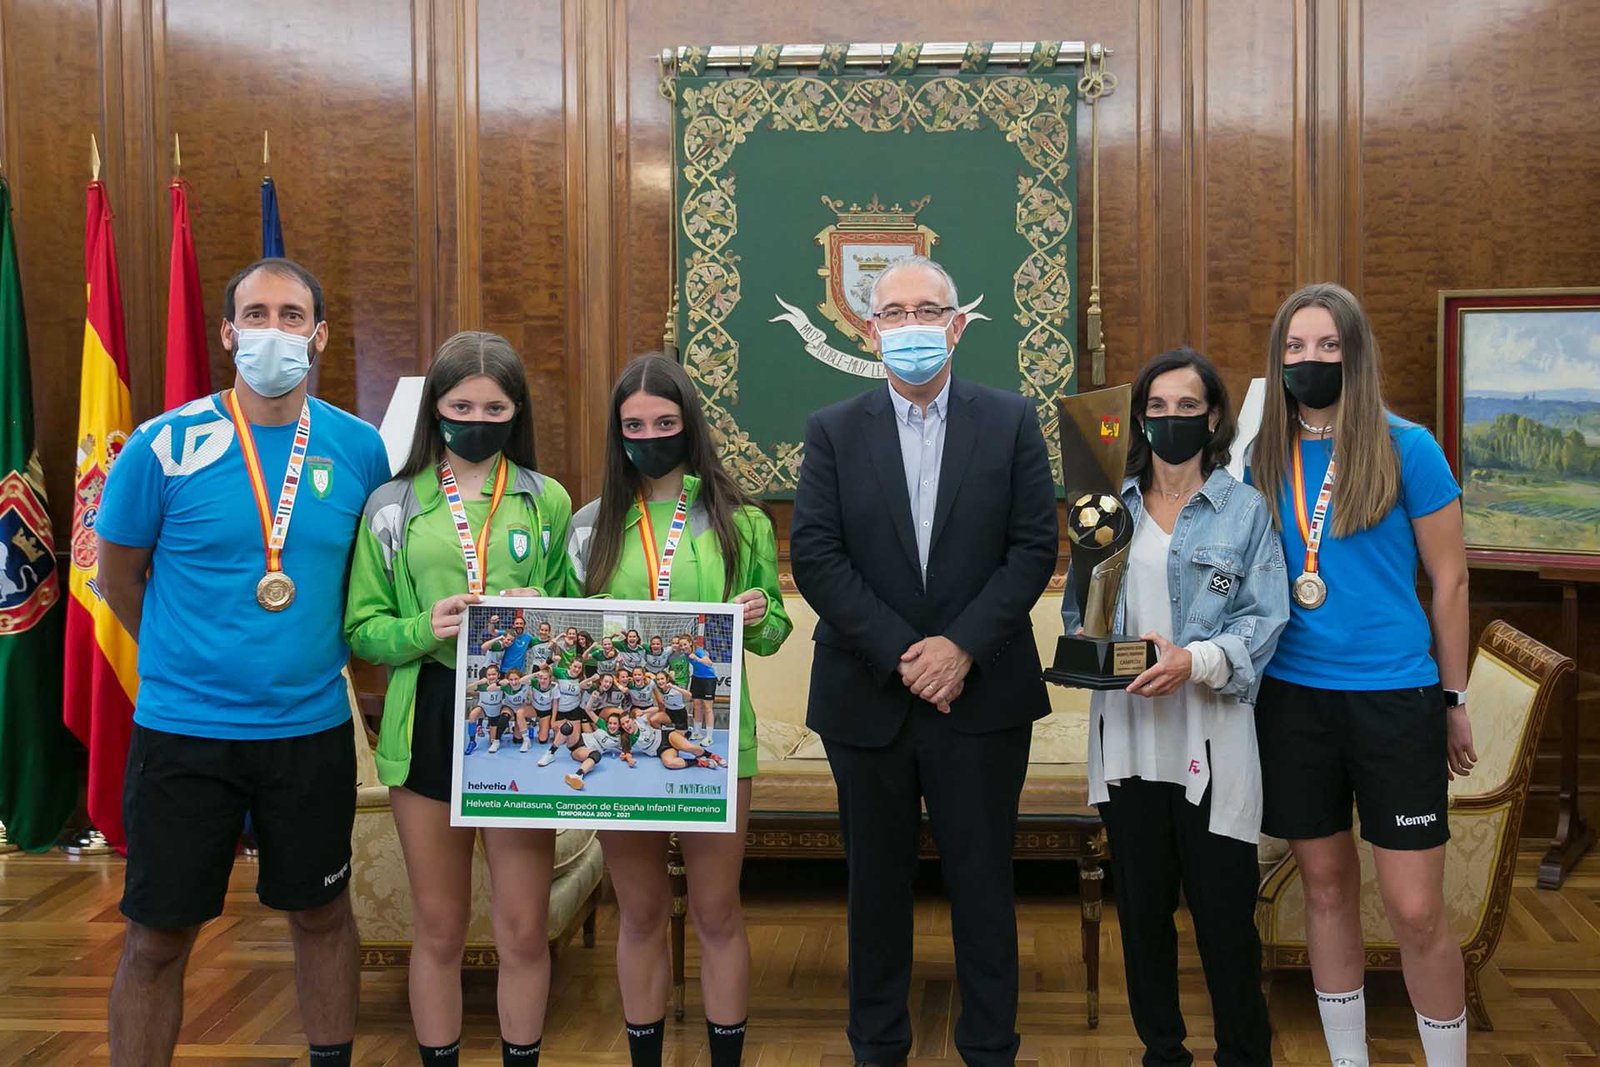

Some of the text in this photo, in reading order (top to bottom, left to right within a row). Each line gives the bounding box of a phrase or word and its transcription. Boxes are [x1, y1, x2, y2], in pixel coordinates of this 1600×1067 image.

[800, 323, 822, 342] MUY
[467, 781, 507, 791] helvetia
[466, 799, 720, 813] Helvetia Anaitasuna, Campeón de España Infantil Femenino
[1395, 813, 1437, 827] Kempa
[713, 1025, 746, 1035] Kem
[434, 1044, 460, 1057] Kem
